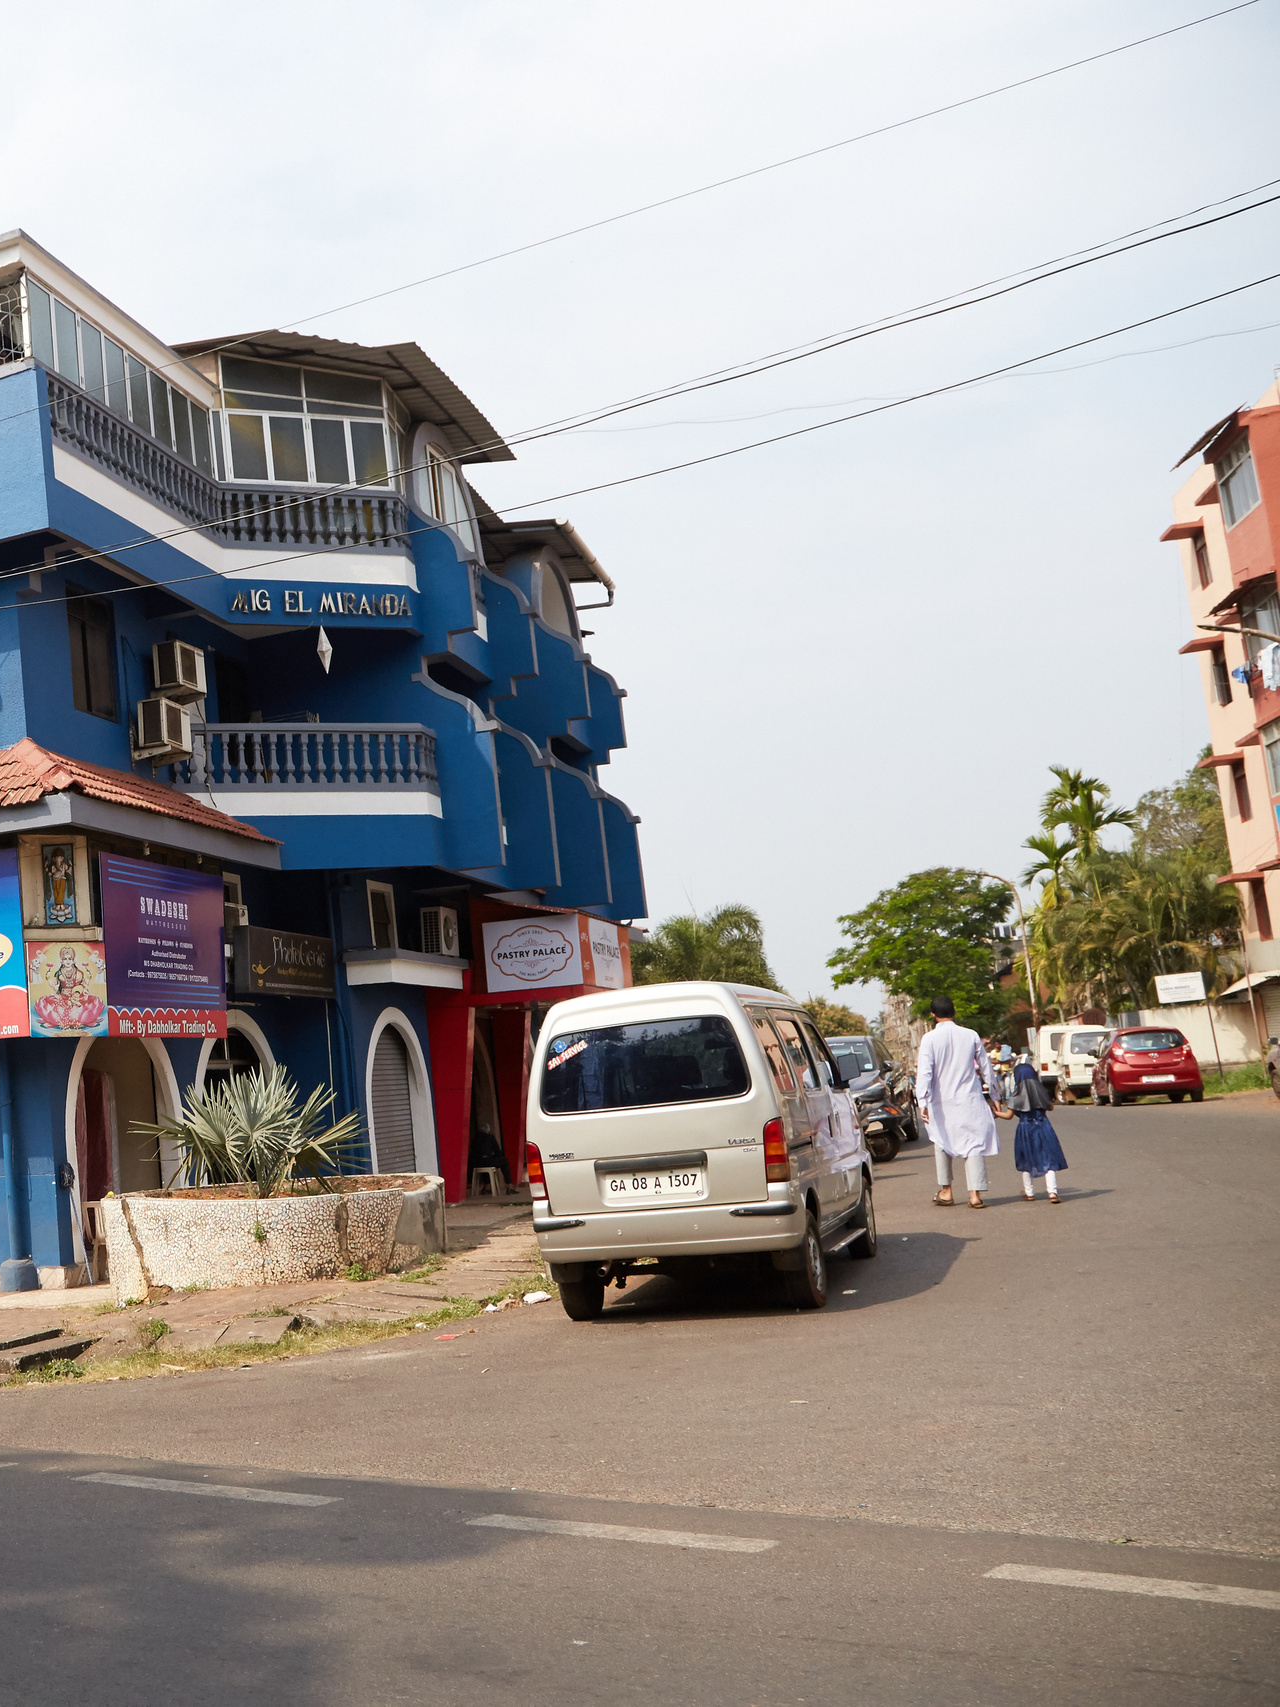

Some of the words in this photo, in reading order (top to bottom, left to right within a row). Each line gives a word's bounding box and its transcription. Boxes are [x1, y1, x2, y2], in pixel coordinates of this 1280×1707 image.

[231, 589, 271, 614] MIG
[284, 590, 312, 613] EL
[319, 592, 412, 616] MIRANDA
[140, 896, 188, 920] SWADESHI
[145, 919, 187, 931] MATTRESSES
[497, 950, 530, 960] PASTRY
[533, 946, 566, 957] PALACE
[137, 1020, 146, 1037] By
[147, 1020, 181, 1034] Dabholkar
[182, 1020, 205, 1037] Trading
[207, 1020, 217, 1033] Co.
[548, 1056, 561, 1070] SAI
[561, 1040, 588, 1061] SERVICE
[610, 1180, 626, 1191] GA
[632, 1177, 648, 1190] 08
[654, 1177, 661, 1188] A
[668, 1173, 697, 1187] 1507
